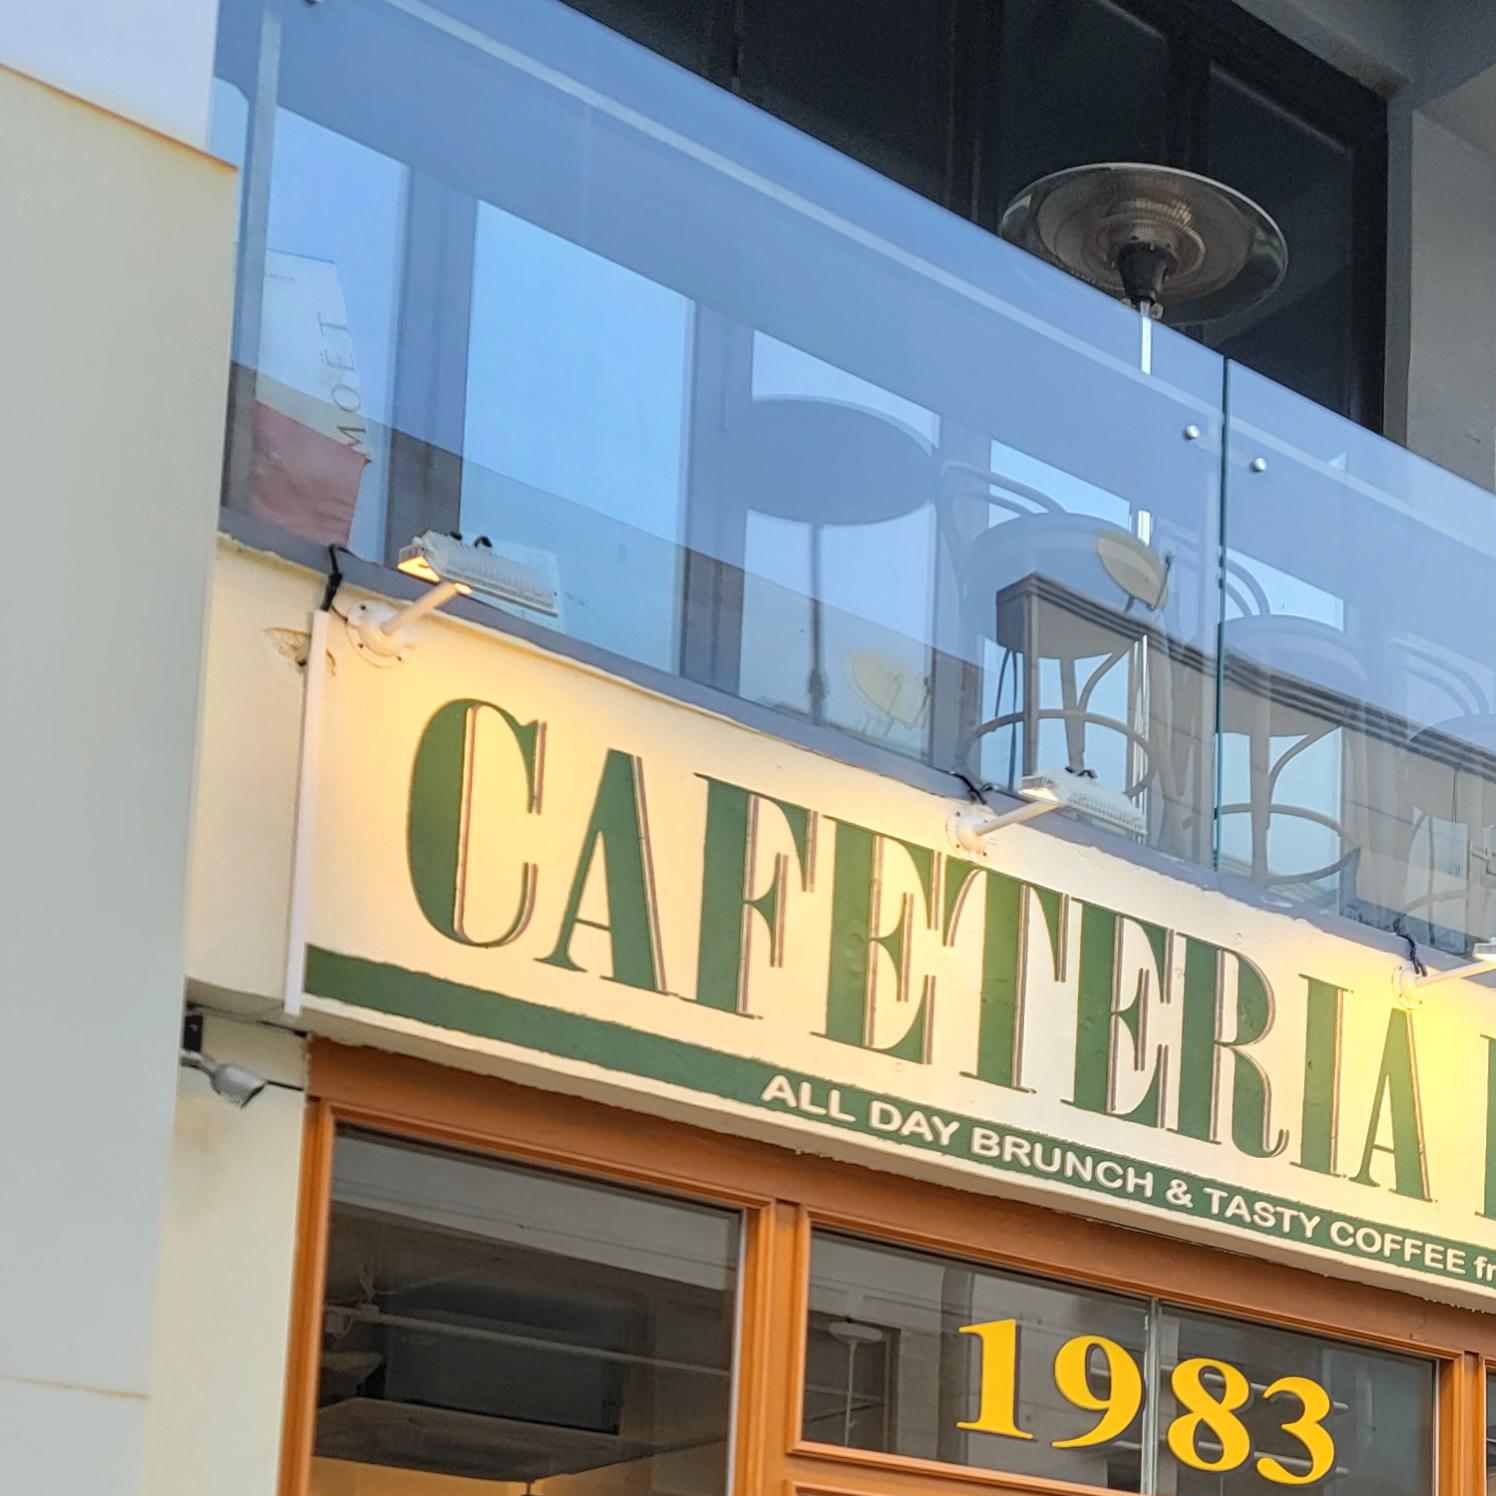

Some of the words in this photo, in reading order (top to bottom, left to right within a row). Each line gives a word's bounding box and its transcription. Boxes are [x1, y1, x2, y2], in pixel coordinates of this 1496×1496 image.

[405, 697, 1435, 1204] CAFETERIA
[762, 1074, 856, 1124] ALL
[869, 1102, 960, 1148] DAY
[972, 1128, 1153, 1199] BRUNCH
[1165, 1179, 1194, 1209] &
[1202, 1188, 1321, 1240] TASTY
[1329, 1219, 1467, 1276] COFFEE
[955, 1317, 1337, 1486] 1983
